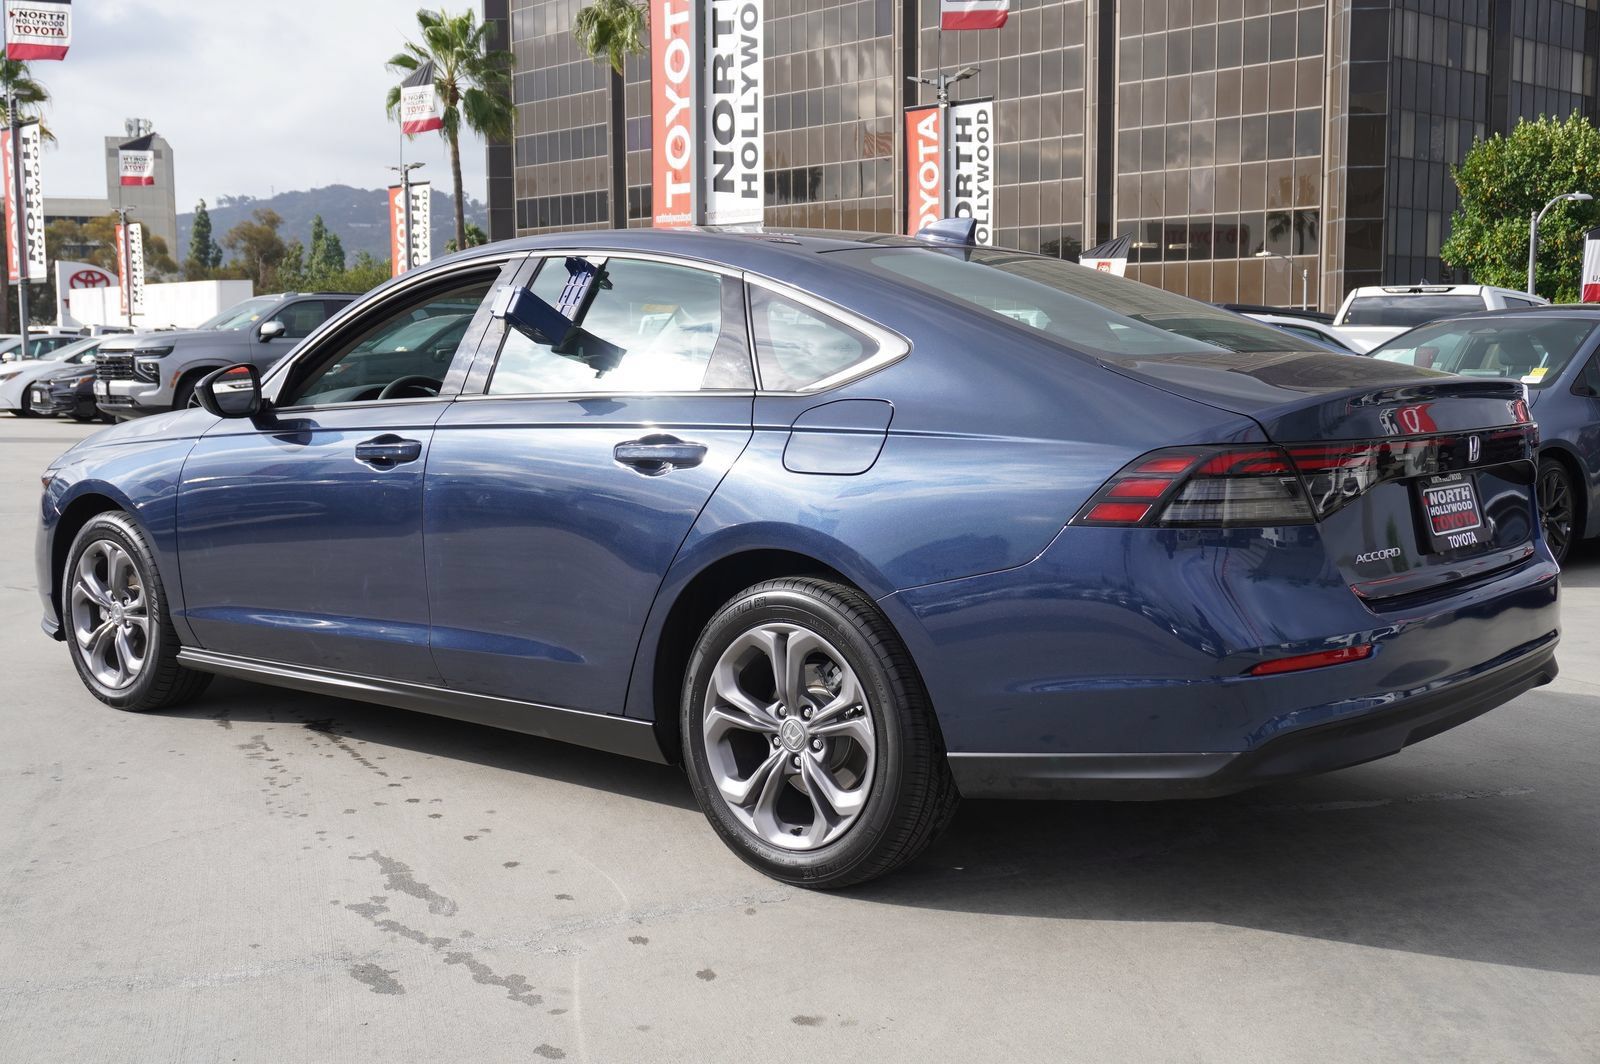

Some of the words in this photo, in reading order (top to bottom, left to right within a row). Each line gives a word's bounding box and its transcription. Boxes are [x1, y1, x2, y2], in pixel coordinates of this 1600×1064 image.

[15, 18, 65, 27] HOLLYWOOD
[15, 25, 65, 36] TOYOTA
[19, 11, 65, 21] NORTH
[664, 0, 690, 208] TOYOT
[712, 0, 734, 193] NORT
[740, 3, 759, 198] HOLLYWO
[22, 137, 36, 262] NORTH
[32, 131, 43, 265] HOLLYWOOD
[917, 111, 939, 232] OYOTA
[955, 117, 973, 218] ORTH
[976, 109, 990, 244] OLLYWOOD
[394, 190, 407, 275] OYOTA
[411, 194, 421, 267] ORTH
[1429, 487, 1471, 505] NORTH
[1430, 501, 1473, 516] HOLLYWOOD
[1432, 511, 1477, 531] TOYOTA
[1355, 547, 1401, 565] ACCORD
[1447, 531, 1478, 548] TOYOTA
